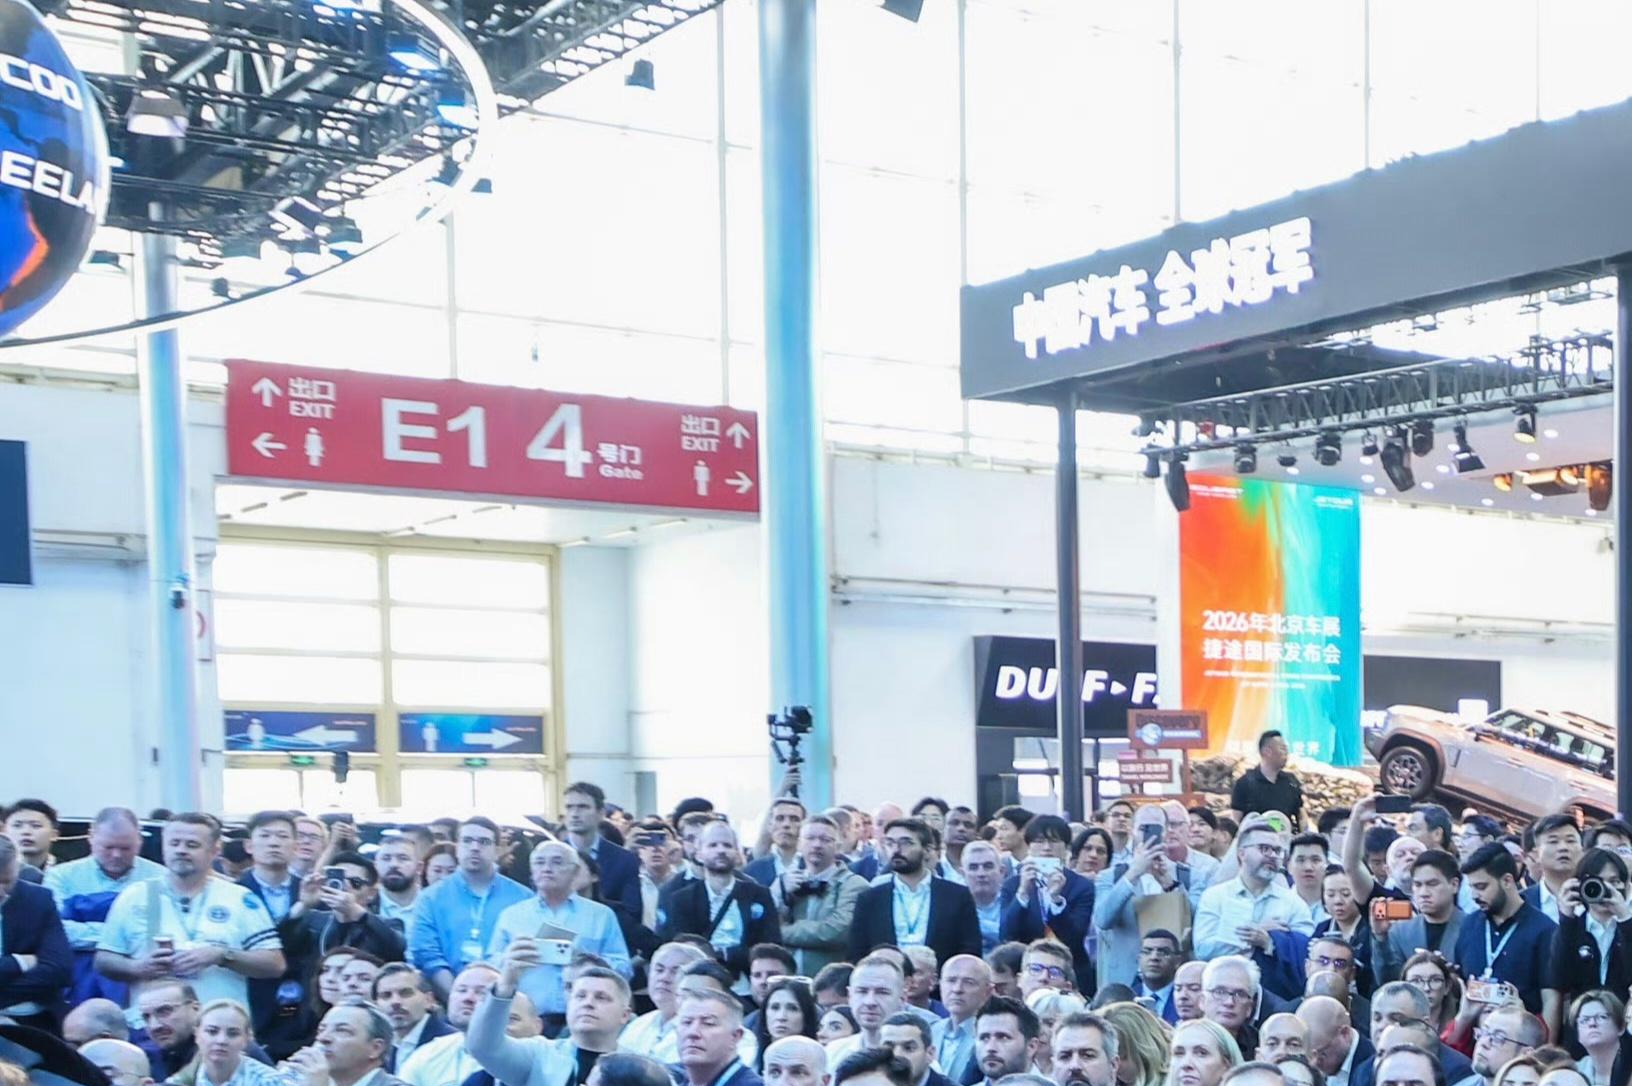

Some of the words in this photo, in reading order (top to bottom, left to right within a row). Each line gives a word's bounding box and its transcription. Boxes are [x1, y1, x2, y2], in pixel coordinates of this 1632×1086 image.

[288, 376, 336, 401] 出口
[288, 401, 336, 419] EXIT
[681, 414, 720, 436] 出口
[381, 397, 488, 468] E1
[526, 403, 593, 478] 4
[681, 436, 720, 452] EXIT
[597, 442, 642, 465] 号门
[598, 465, 644, 480] Gate
[1202, 610, 1341, 638] 2026年北京车展
[1202, 637, 1341, 665] 捷途国际发布会
